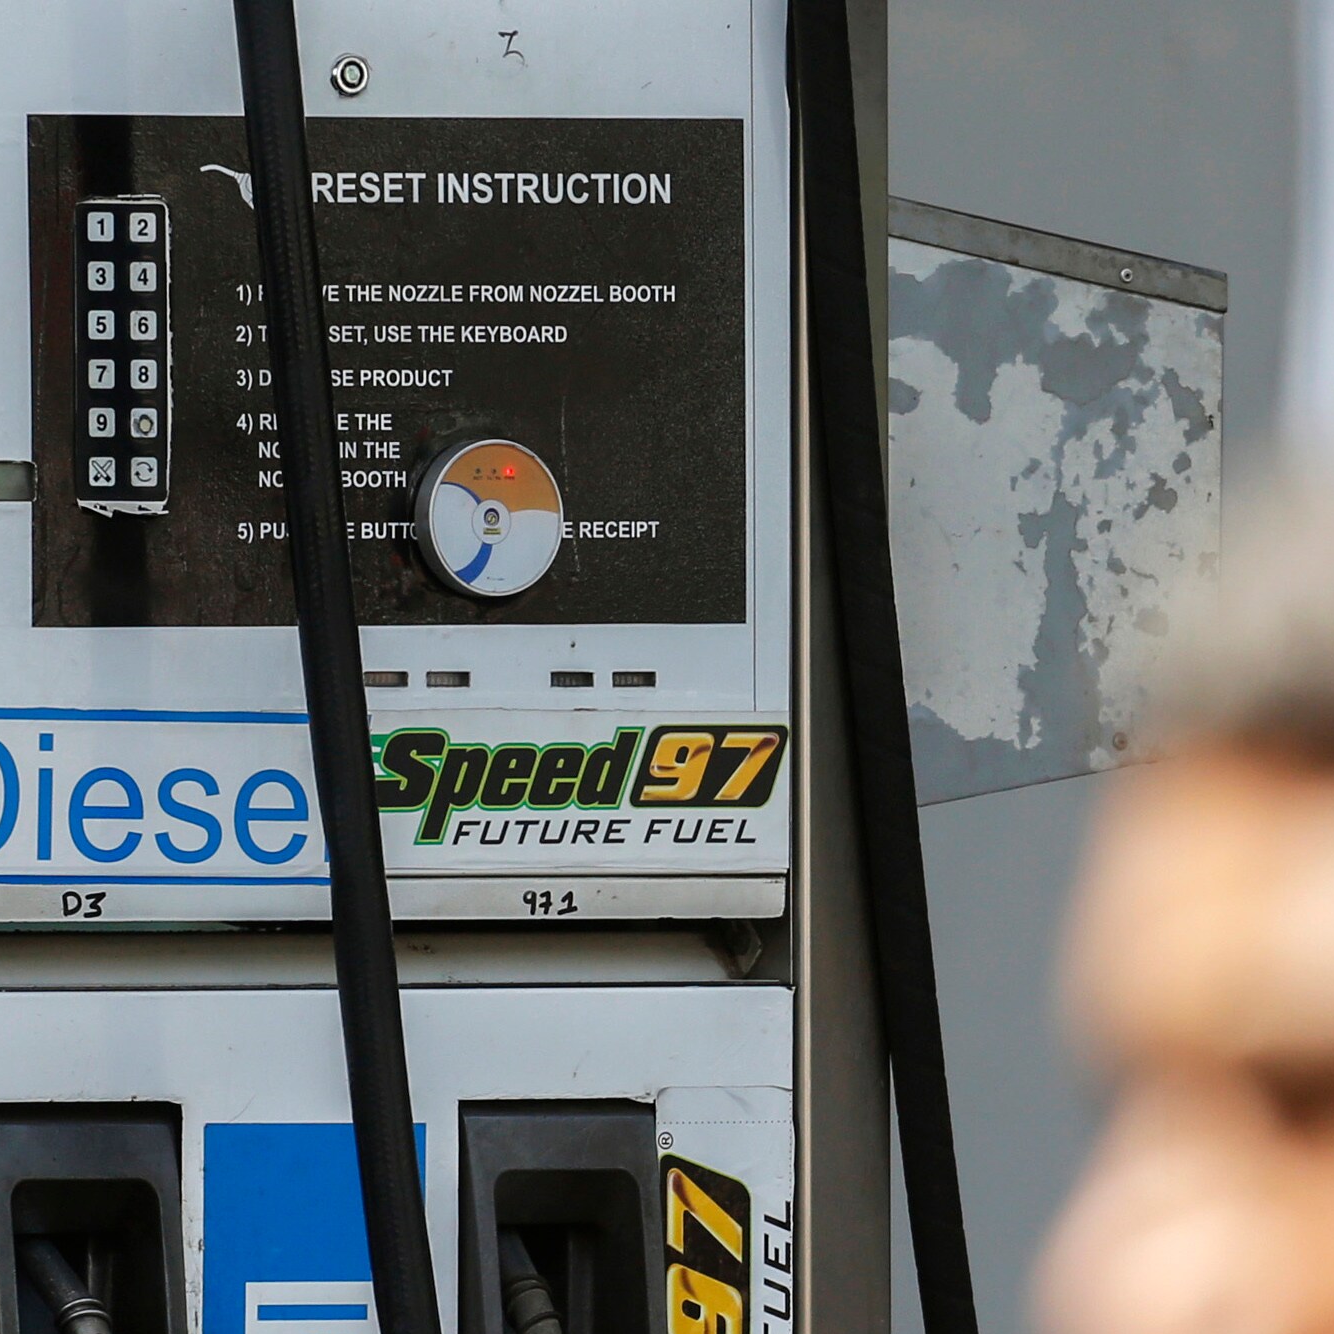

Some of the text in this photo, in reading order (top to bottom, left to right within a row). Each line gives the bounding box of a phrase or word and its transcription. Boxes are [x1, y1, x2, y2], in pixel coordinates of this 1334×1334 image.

[312, 172, 670, 204] RESET INSTRUCTION
[97, 218, 148, 236] 1 2
[96, 268, 148, 285] 3 4
[237, 285, 251, 305] 1)
[345, 285, 382, 301] THE
[389, 285, 463, 302] NOZZLE
[470, 285, 523, 302] FROM
[530, 285, 604, 302] NOZZEL
[610, 285, 675, 302] BOOTH
[96, 316, 148, 334] 5 6
[236, 325, 252, 346] 2)
[329, 326, 367, 345] SET,
[374, 326, 411, 342] USE
[418, 326, 455, 342] THE
[462, 326, 567, 342] KEYBOARD
[96, 365, 148, 383] 7 8
[237, 369, 252, 390] 3)
[361, 370, 453, 386] PRODUCT
[97, 414, 107, 431] 9
[237, 414, 253, 434] 4)
[355, 414, 392, 430] THE
[340, 442, 400, 458] IN THE
[342, 471, 406, 487] BOOTH
[238, 523, 253, 543] 5)
[580, 521, 659, 538] RECEIPT
[375, 727, 779, 846] Speed 97
[452, 818, 757, 846] FUTURE FUEL
[61, 891, 107, 919] D3
